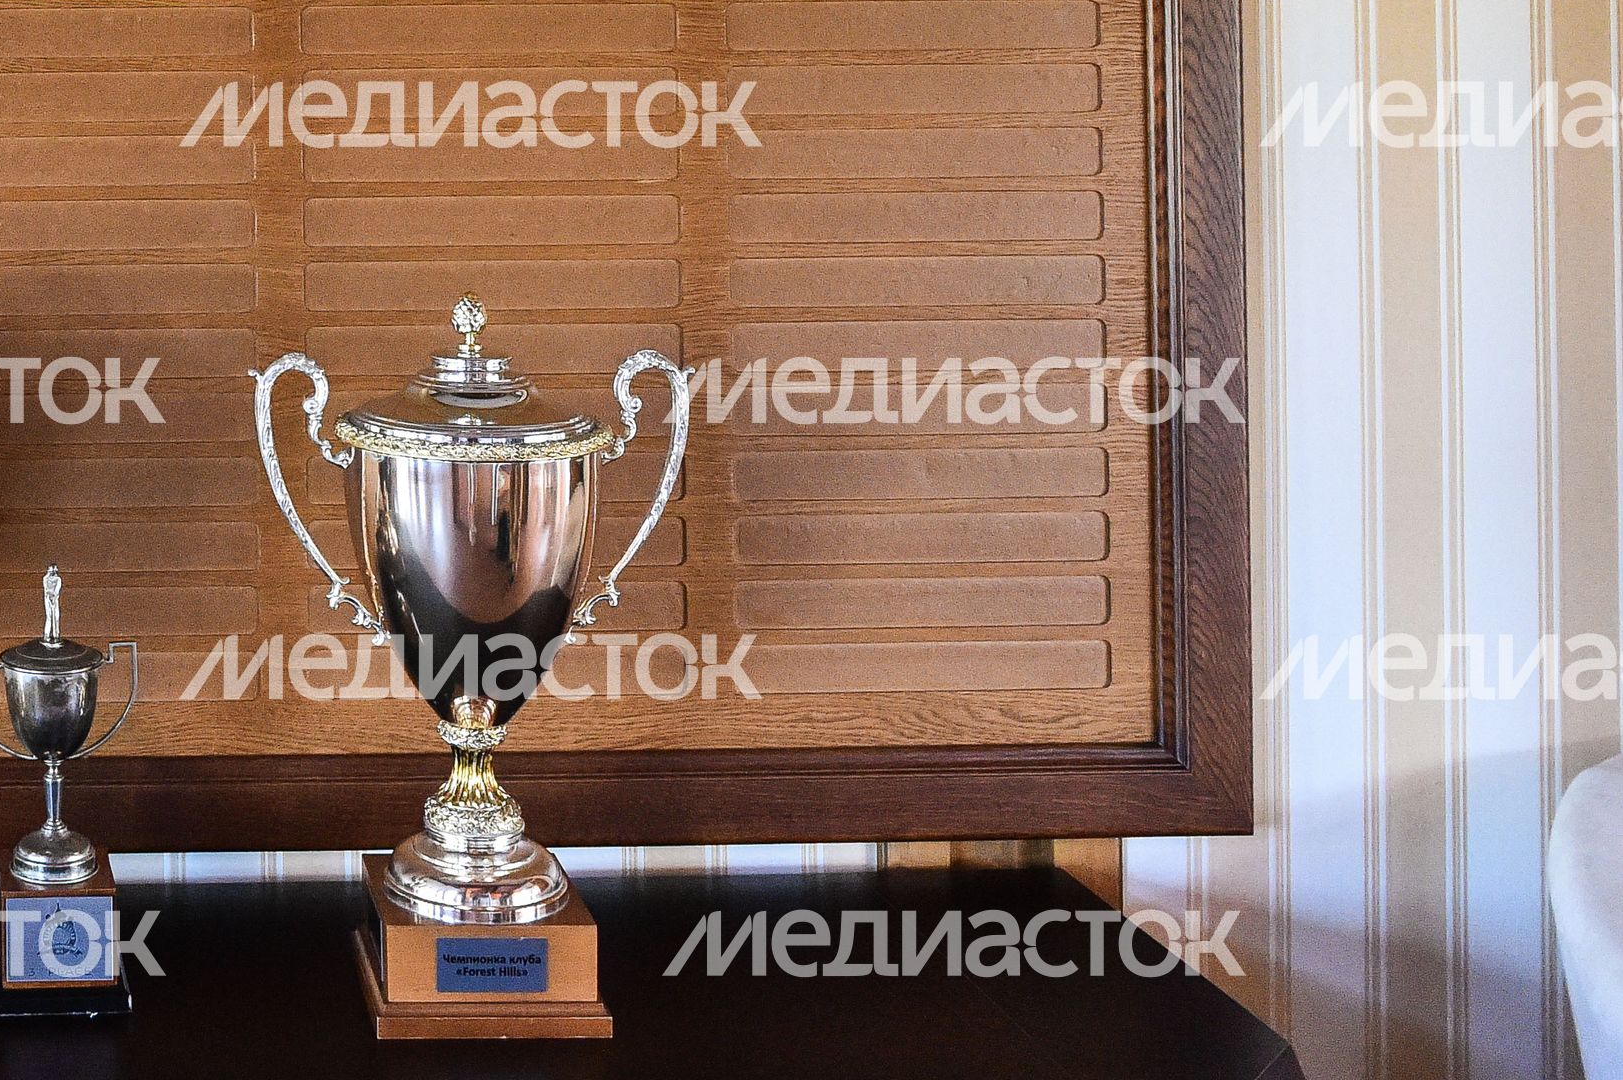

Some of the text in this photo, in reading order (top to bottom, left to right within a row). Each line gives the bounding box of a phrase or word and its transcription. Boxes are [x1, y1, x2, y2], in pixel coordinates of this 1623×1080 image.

[442, 954, 542, 967] Чемпионка клуба
[456, 966, 529, 977] «Forest Hills»
